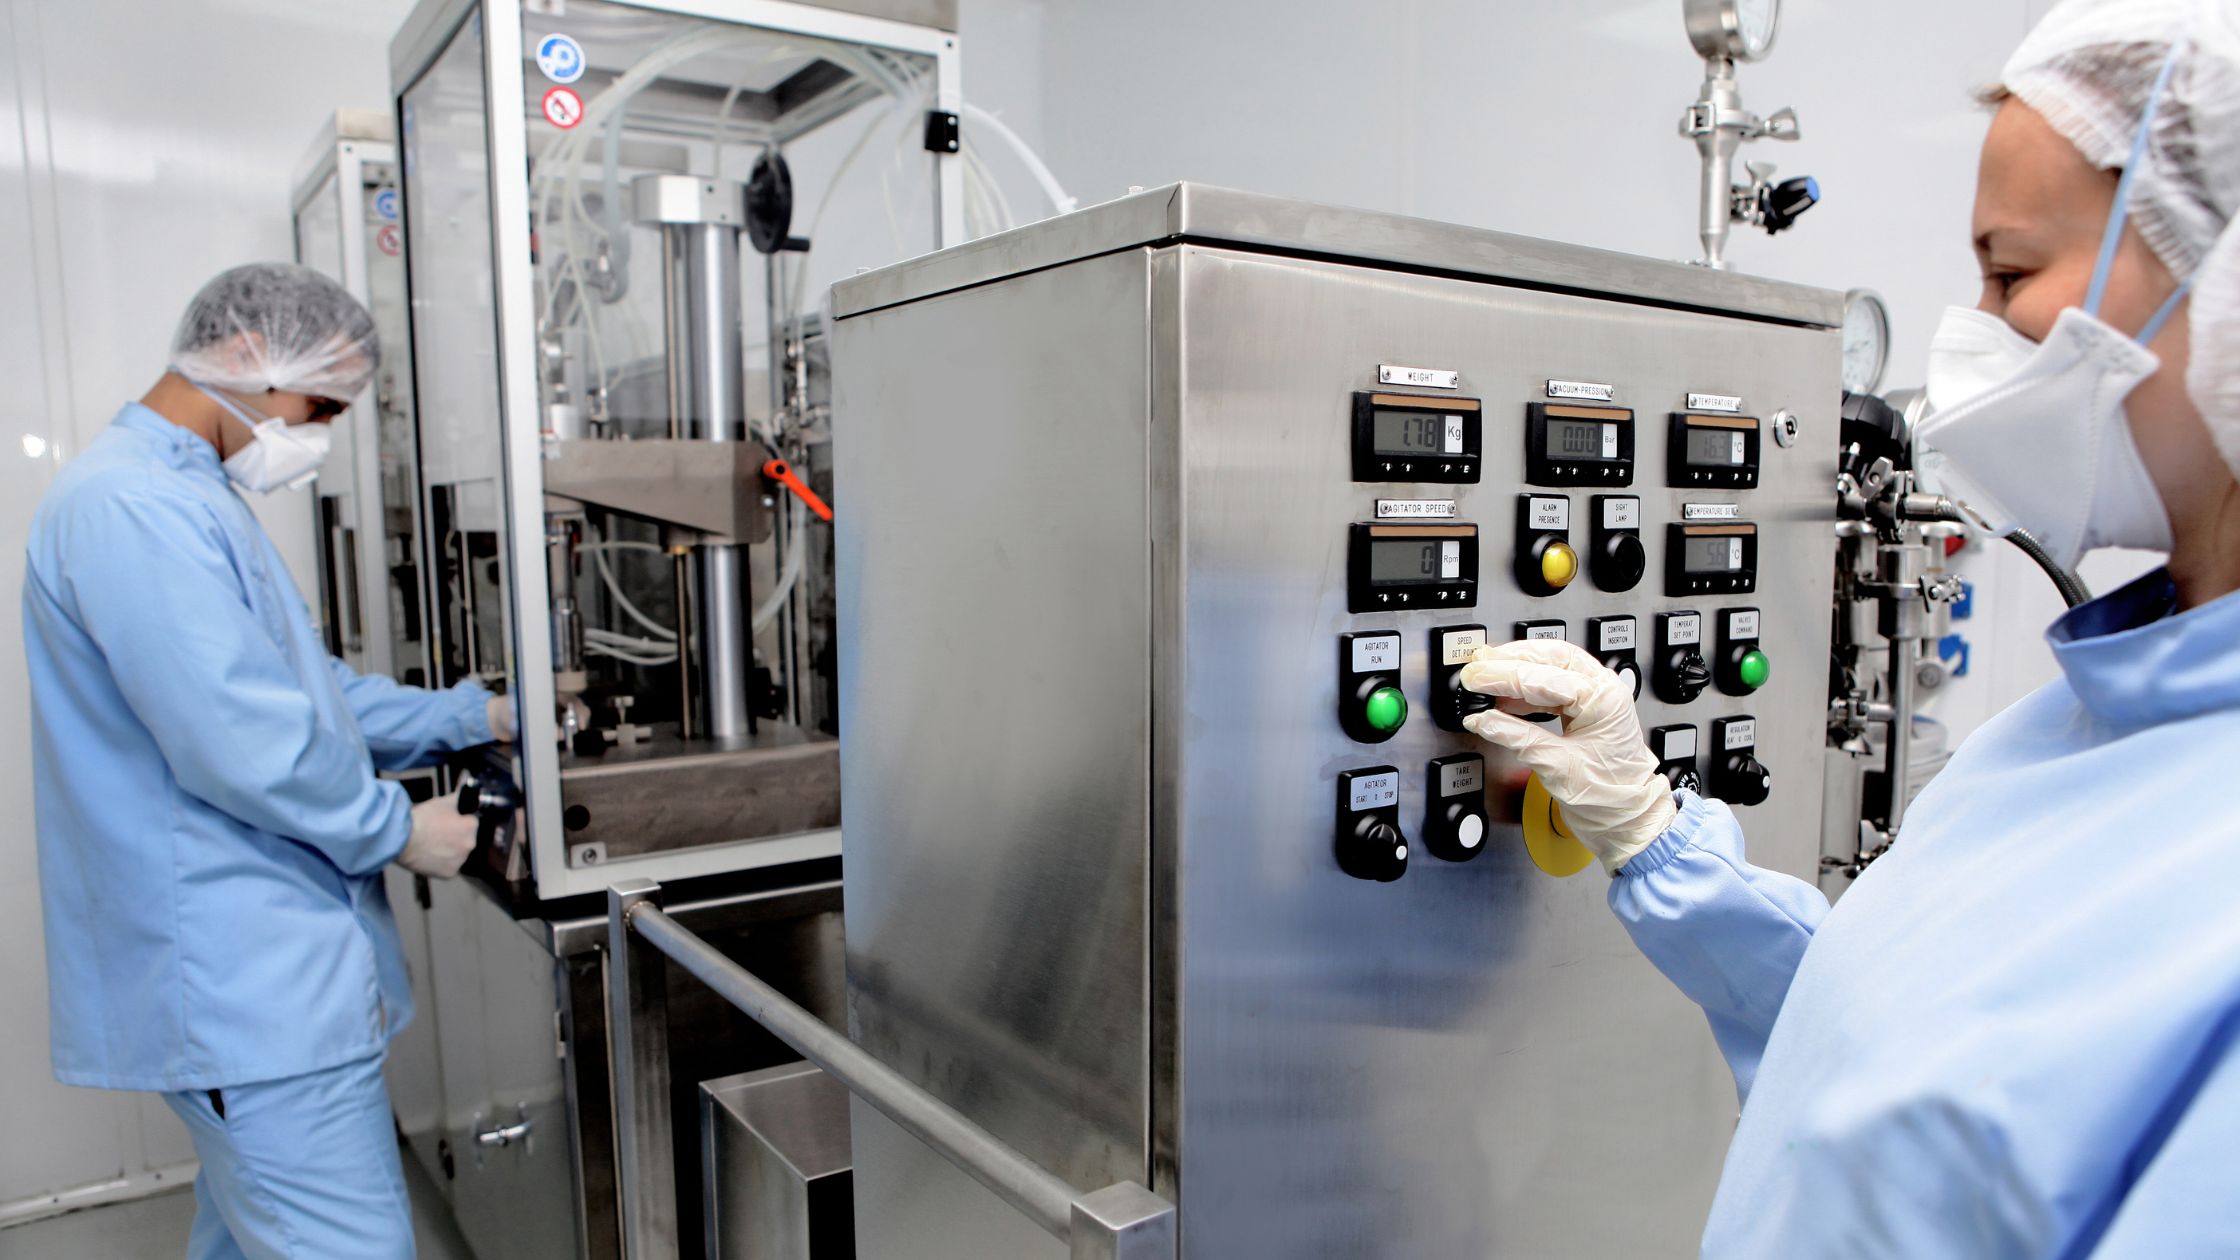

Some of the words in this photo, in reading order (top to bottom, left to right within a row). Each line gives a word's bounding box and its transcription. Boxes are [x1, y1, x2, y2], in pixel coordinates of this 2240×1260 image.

[1407, 371, 1434, 383] WEIGHT
[1447, 425, 1461, 441] Kg
[1387, 503, 1422, 513] AGITATOR
[1425, 504, 1447, 513] SPEED
[1542, 503, 1557, 512] ALARM
[1691, 507, 1723, 515] EMPERATURE
[1538, 515, 1560, 524] PRESENCE
[1421, 546, 1434, 574] 0
[1443, 554, 1459, 564] Rpm
[1607, 624, 1629, 634] CONTROLS
[1457, 636, 1472, 645] SPEED
[1534, 631, 1558, 640] CONTROLS
[1364, 641, 1389, 651] AGITATOR
[1371, 656, 1382, 664] RUN
[1456, 765, 1470, 776] TARE
[1364, 779, 1387, 789] AGITATOR
[1452, 777, 1472, 789] WEIGHT
